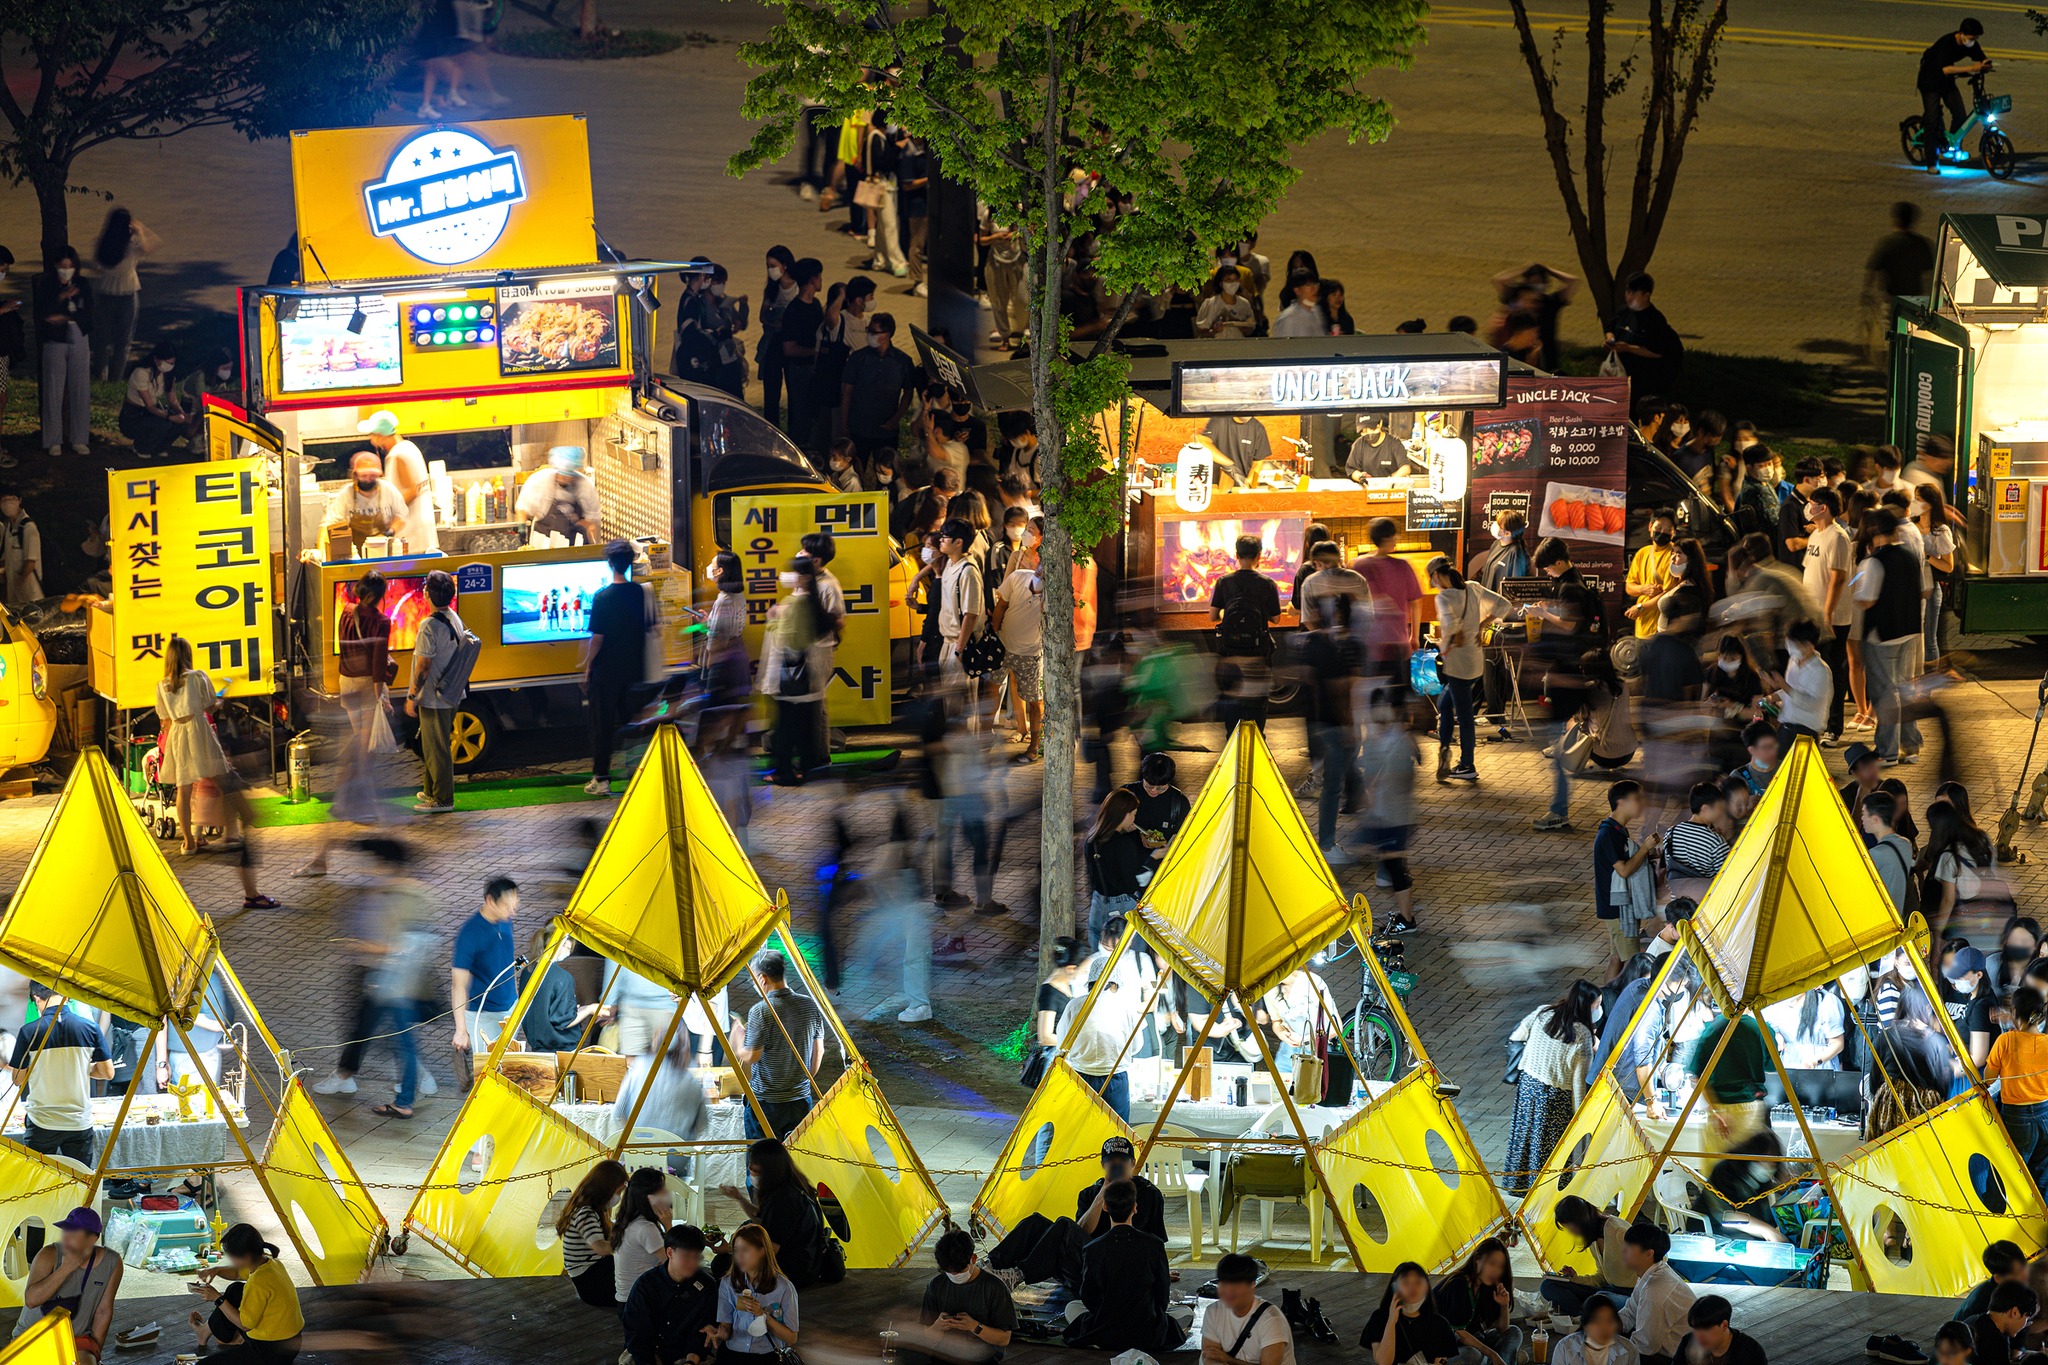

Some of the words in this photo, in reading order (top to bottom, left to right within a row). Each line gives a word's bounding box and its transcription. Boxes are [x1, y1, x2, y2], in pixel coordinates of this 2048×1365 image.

[1995, 214, 2048, 248] P
[1271, 369, 1345, 402] UNCLE
[1348, 365, 1411, 400] JACK
[1516, 389, 1558, 404] UNCLE
[1560, 389, 1591, 404] JACK
[1915, 371, 1935, 432] cooking
[1549, 427, 1569, 438] 직화
[1569, 426, 1597, 438] 소고기
[1598, 425, 1625, 438] 불초밥
[1550, 444, 1562, 454] 8p
[1568, 443, 1596, 453] 9,000
[1550, 456, 1567, 467] 10p
[1568, 456, 1600, 466] 10,000
[1491, 498, 1510, 506] SOLD
[1511, 498, 1527, 506] OUT
[126, 479, 163, 600] 다시찾는
[194, 471, 264, 683] 타코야끼
[464, 577, 486, 589] 24-2
